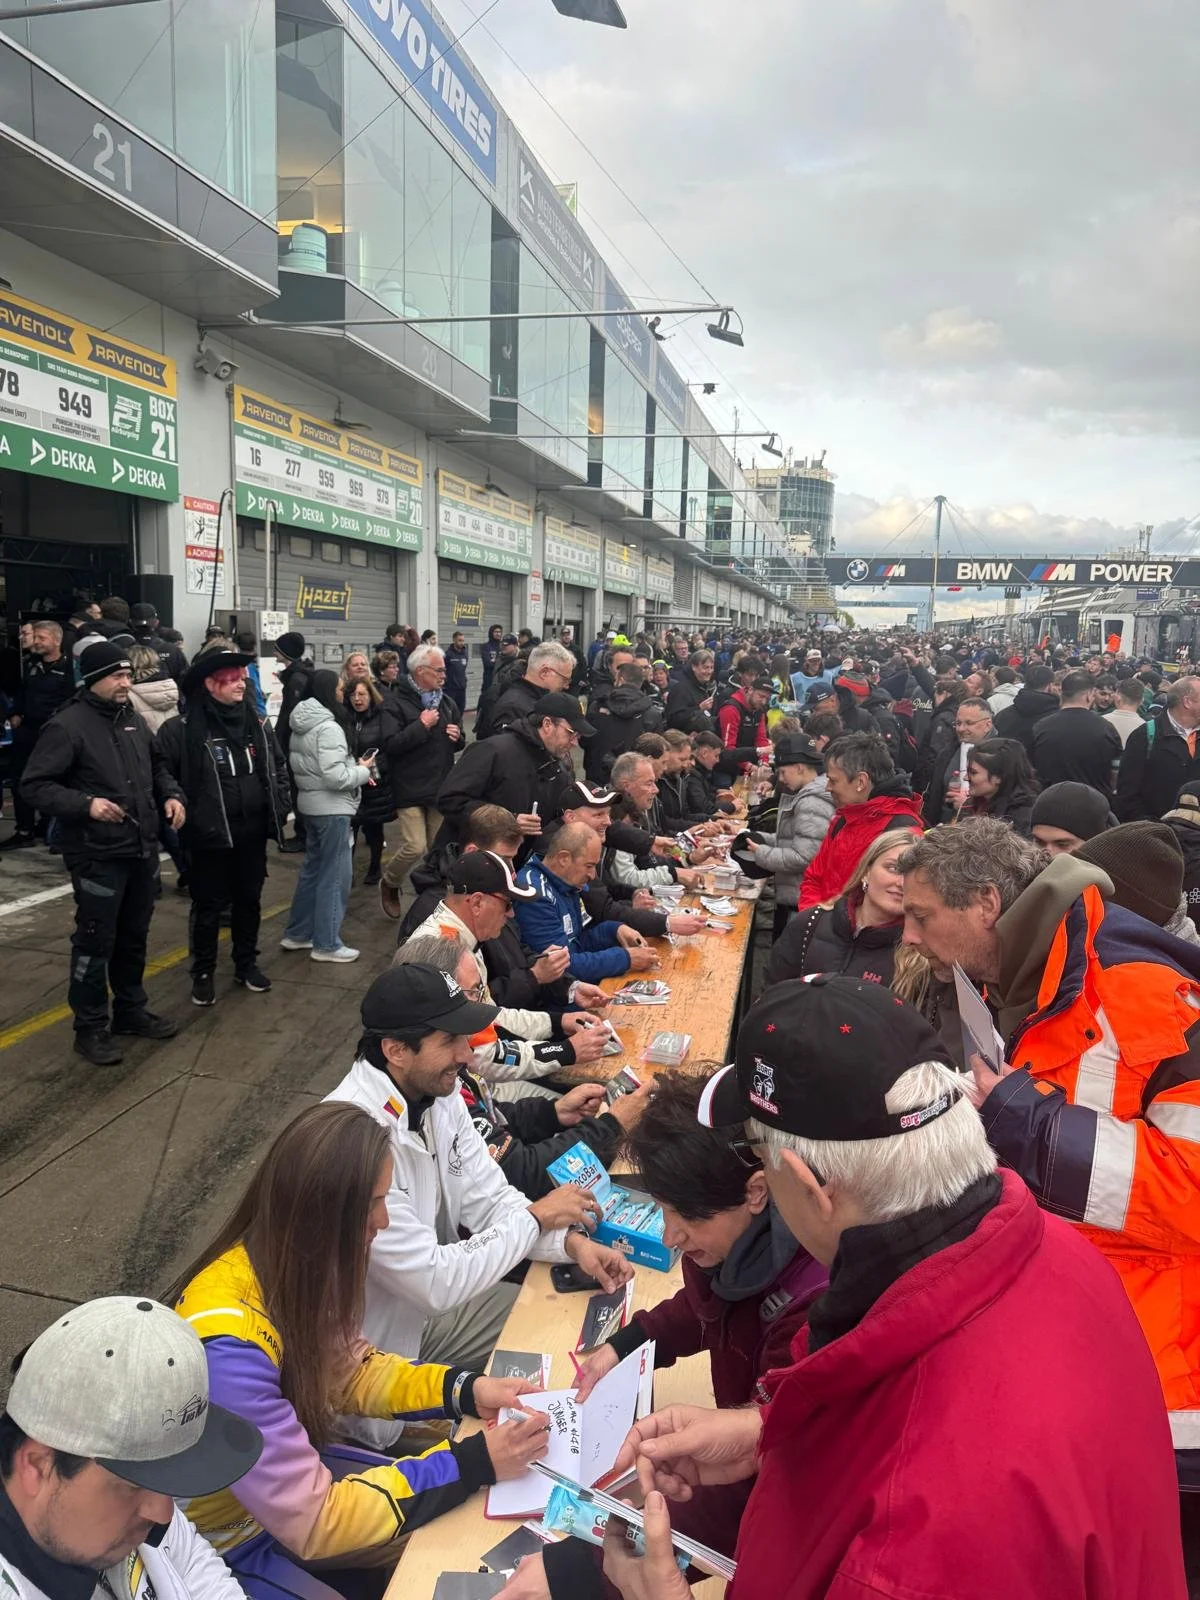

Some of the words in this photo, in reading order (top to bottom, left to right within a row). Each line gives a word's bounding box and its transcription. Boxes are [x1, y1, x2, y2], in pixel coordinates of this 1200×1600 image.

[369, 0, 427, 70] YO
[429, 44, 492, 157] TIRES
[93, 122, 132, 192] 21
[0, 306, 67, 345] AVENOL
[96, 345, 161, 380] RAVENOL
[59, 387, 92, 418] 949
[149, 395, 175, 423] BOX
[245, 402, 289, 427] RAVENOL
[303, 424, 339, 446] RAVENOL
[151, 421, 176, 461] 21
[51, 447, 97, 474] DEKRA
[129, 466, 166, 490] DEKRA
[250, 447, 261, 467] 16
[285, 458, 301, 479] 277
[258, 496, 284, 515] DERA
[302, 507, 325, 524] DEKRA
[340, 516, 360, 533] DEKRA
[373, 523, 391, 539] DEKRA
[409, 502, 422, 526] 20
[192, 548, 218, 559] ACHTUN
[956, 562, 1013, 581] BMW
[1089, 562, 1174, 583] POWER
[302, 586, 347, 608] HAZET
[456, 601, 480, 616] HAZET
[863, 971, 882, 984] HH
[750, 1091, 779, 1115] BROTHERS
